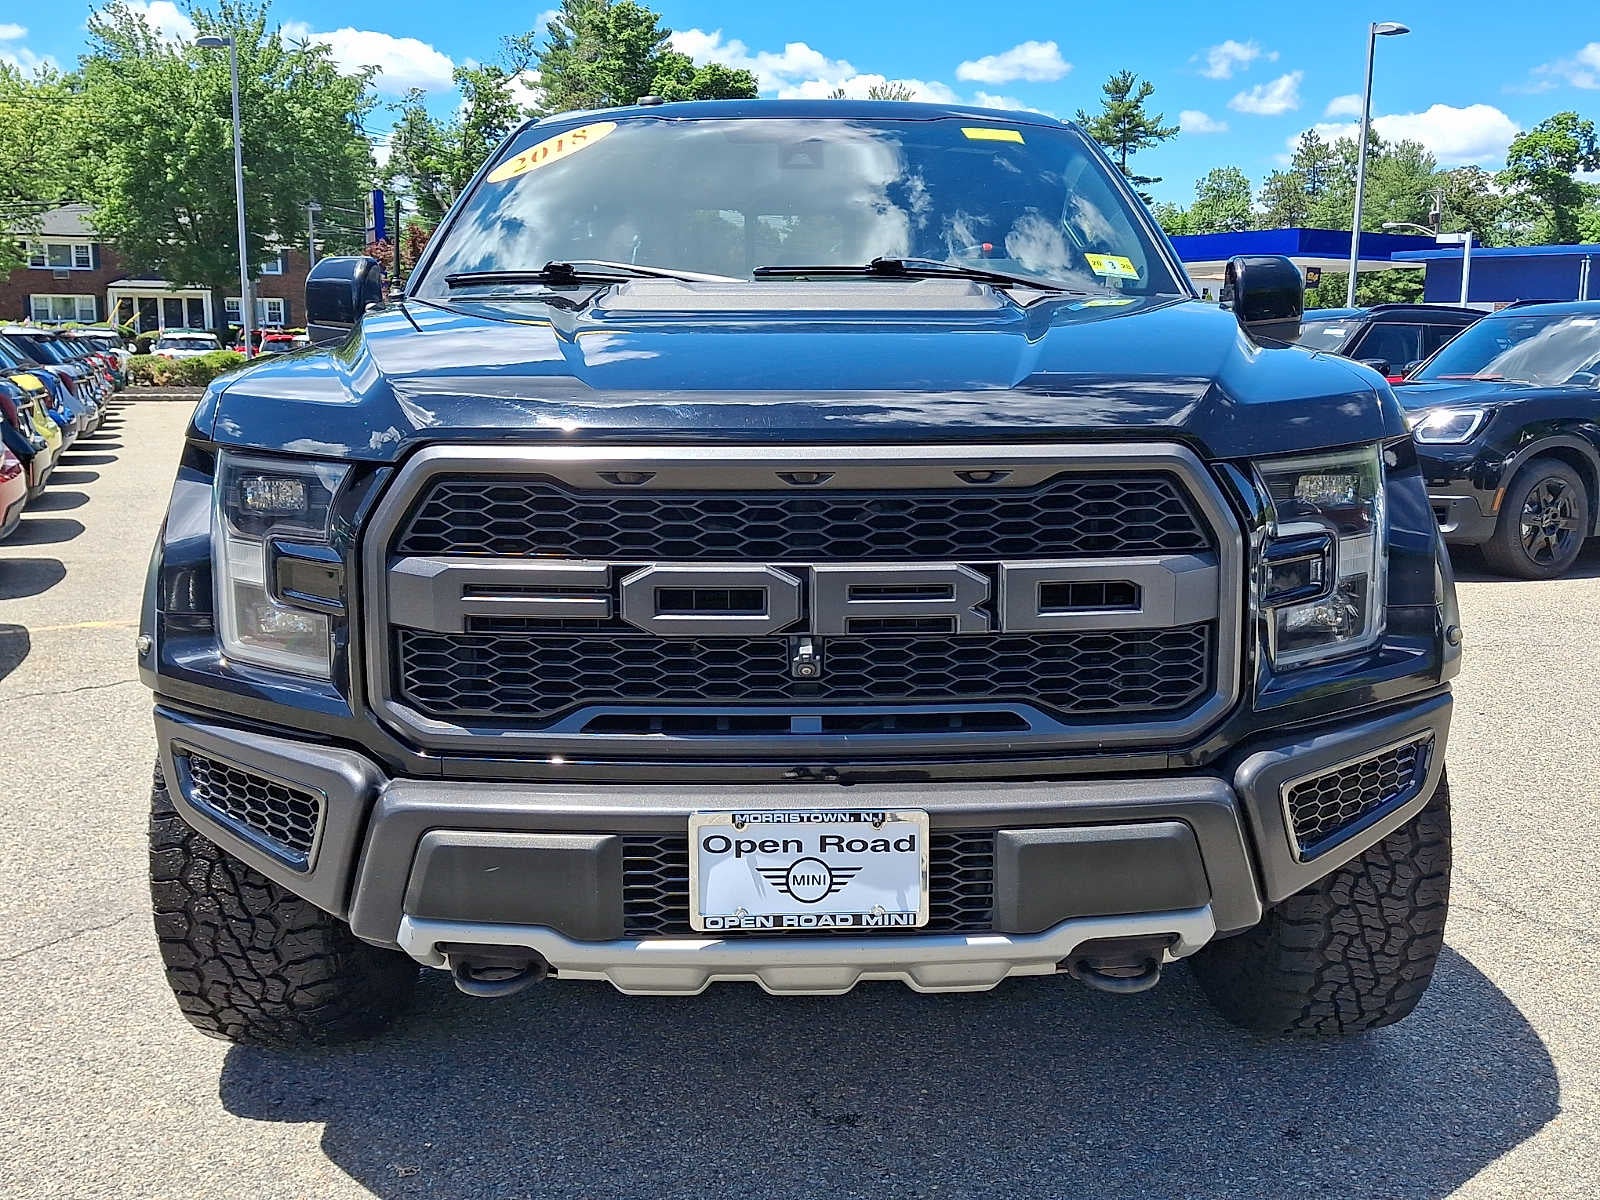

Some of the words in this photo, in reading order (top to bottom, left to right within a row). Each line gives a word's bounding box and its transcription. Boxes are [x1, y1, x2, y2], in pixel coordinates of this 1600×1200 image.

[513, 129, 588, 173] 2018
[390, 557, 1219, 636] FORD
[860, 812, 883, 822] NJ
[702, 834, 803, 858] Open
[819, 834, 916, 853] Road
[792, 874, 827, 886] MINI
[705, 915, 774, 929] OPEN
[782, 914, 854, 927] ROAD
[861, 913, 915, 926] MINI
